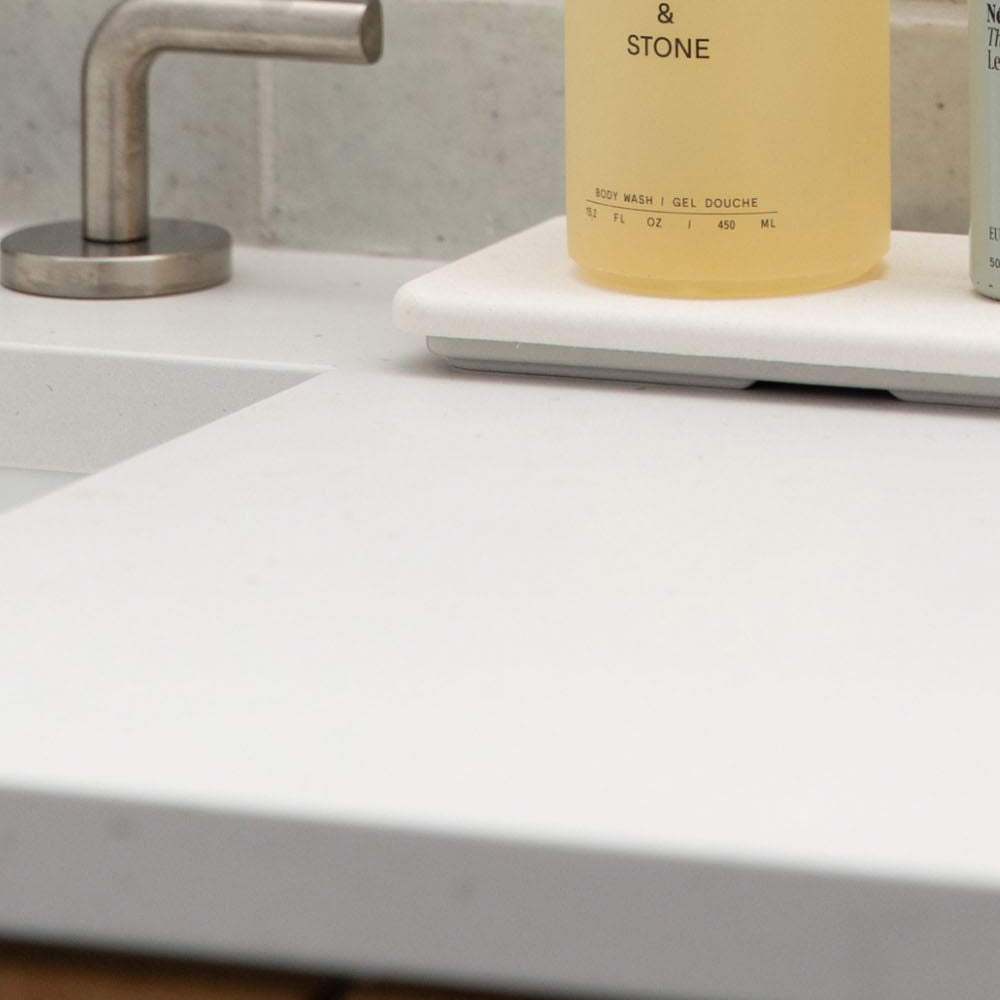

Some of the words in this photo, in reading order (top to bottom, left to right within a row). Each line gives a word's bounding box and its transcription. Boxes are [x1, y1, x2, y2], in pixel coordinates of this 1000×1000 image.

[657, 2, 674, 24] &
[627, 34, 710, 59] STONE
[988, 50, 1000, 71] Le
[595, 188, 618, 200] BODY
[623, 193, 653, 205] WASH
[672, 197, 697, 208] GEL
[705, 198, 758, 208] DOUCHE
[613, 213, 625, 224] FL
[647, 217, 662, 228] OZ
[718, 219, 736, 231] 450
[761, 218, 776, 229] ML
[990, 257, 1000, 269] 50
